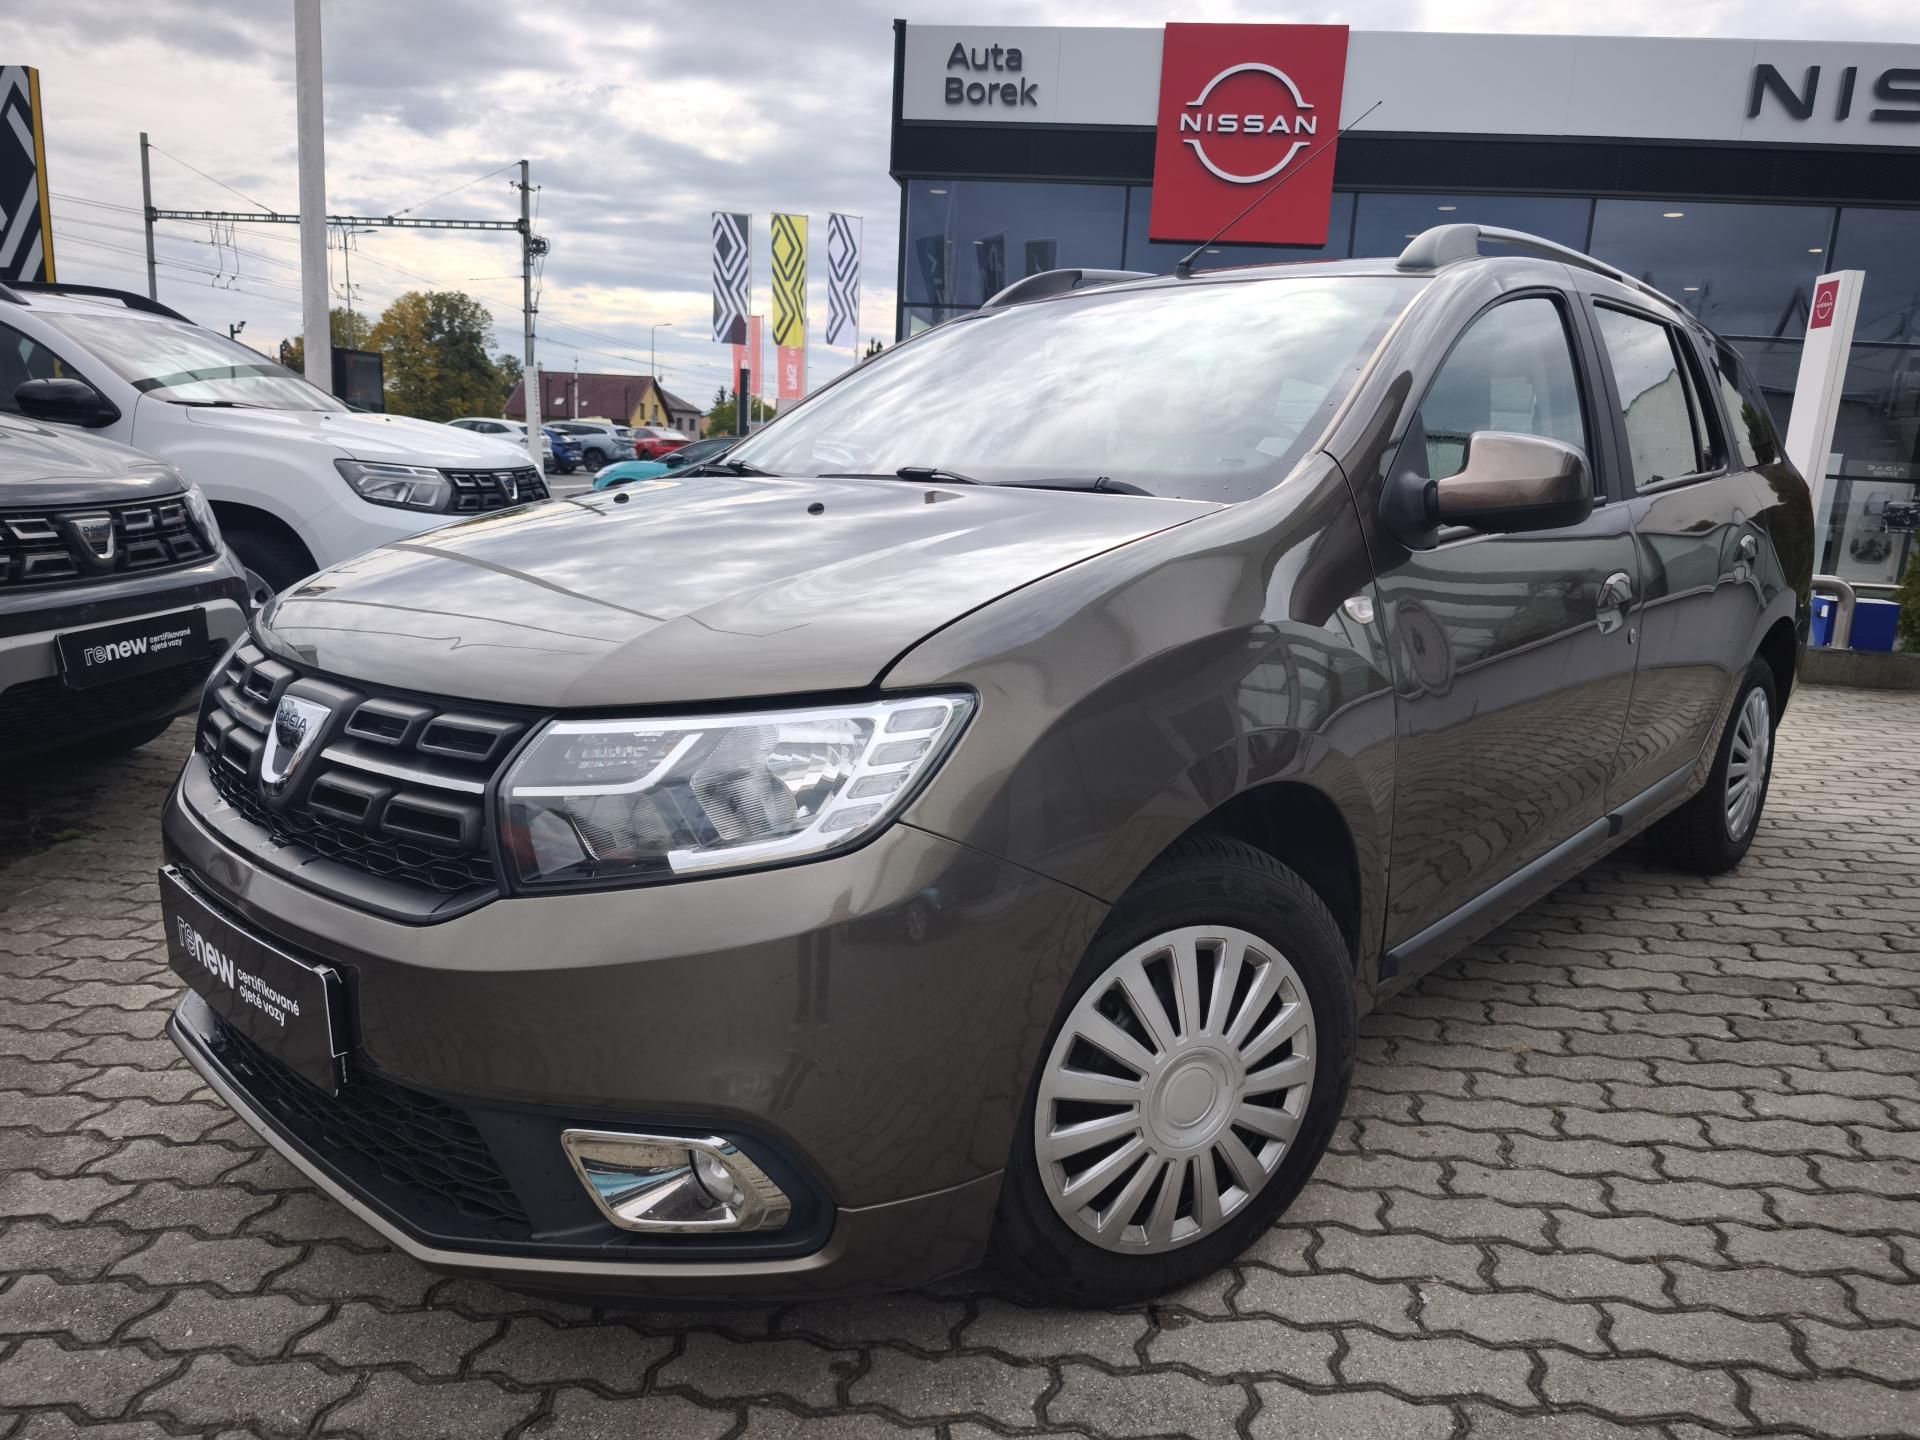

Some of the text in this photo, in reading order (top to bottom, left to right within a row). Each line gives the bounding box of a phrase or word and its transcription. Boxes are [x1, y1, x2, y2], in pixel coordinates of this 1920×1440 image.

[946, 42, 1022, 71] Auta
[945, 76, 1038, 106] Borek
[1747, 63, 1920, 122] NIS
[1179, 112, 1317, 135] NISSAN
[149, 627, 191, 644] certifikované
[151, 638, 182, 652] ojeté vozy
[84, 637, 147, 666] renew
[278, 710, 307, 732] DACIA
[177, 915, 235, 989] renew
[237, 968, 300, 1016] certifikované
[239, 984, 285, 1027] ojeté vozy
